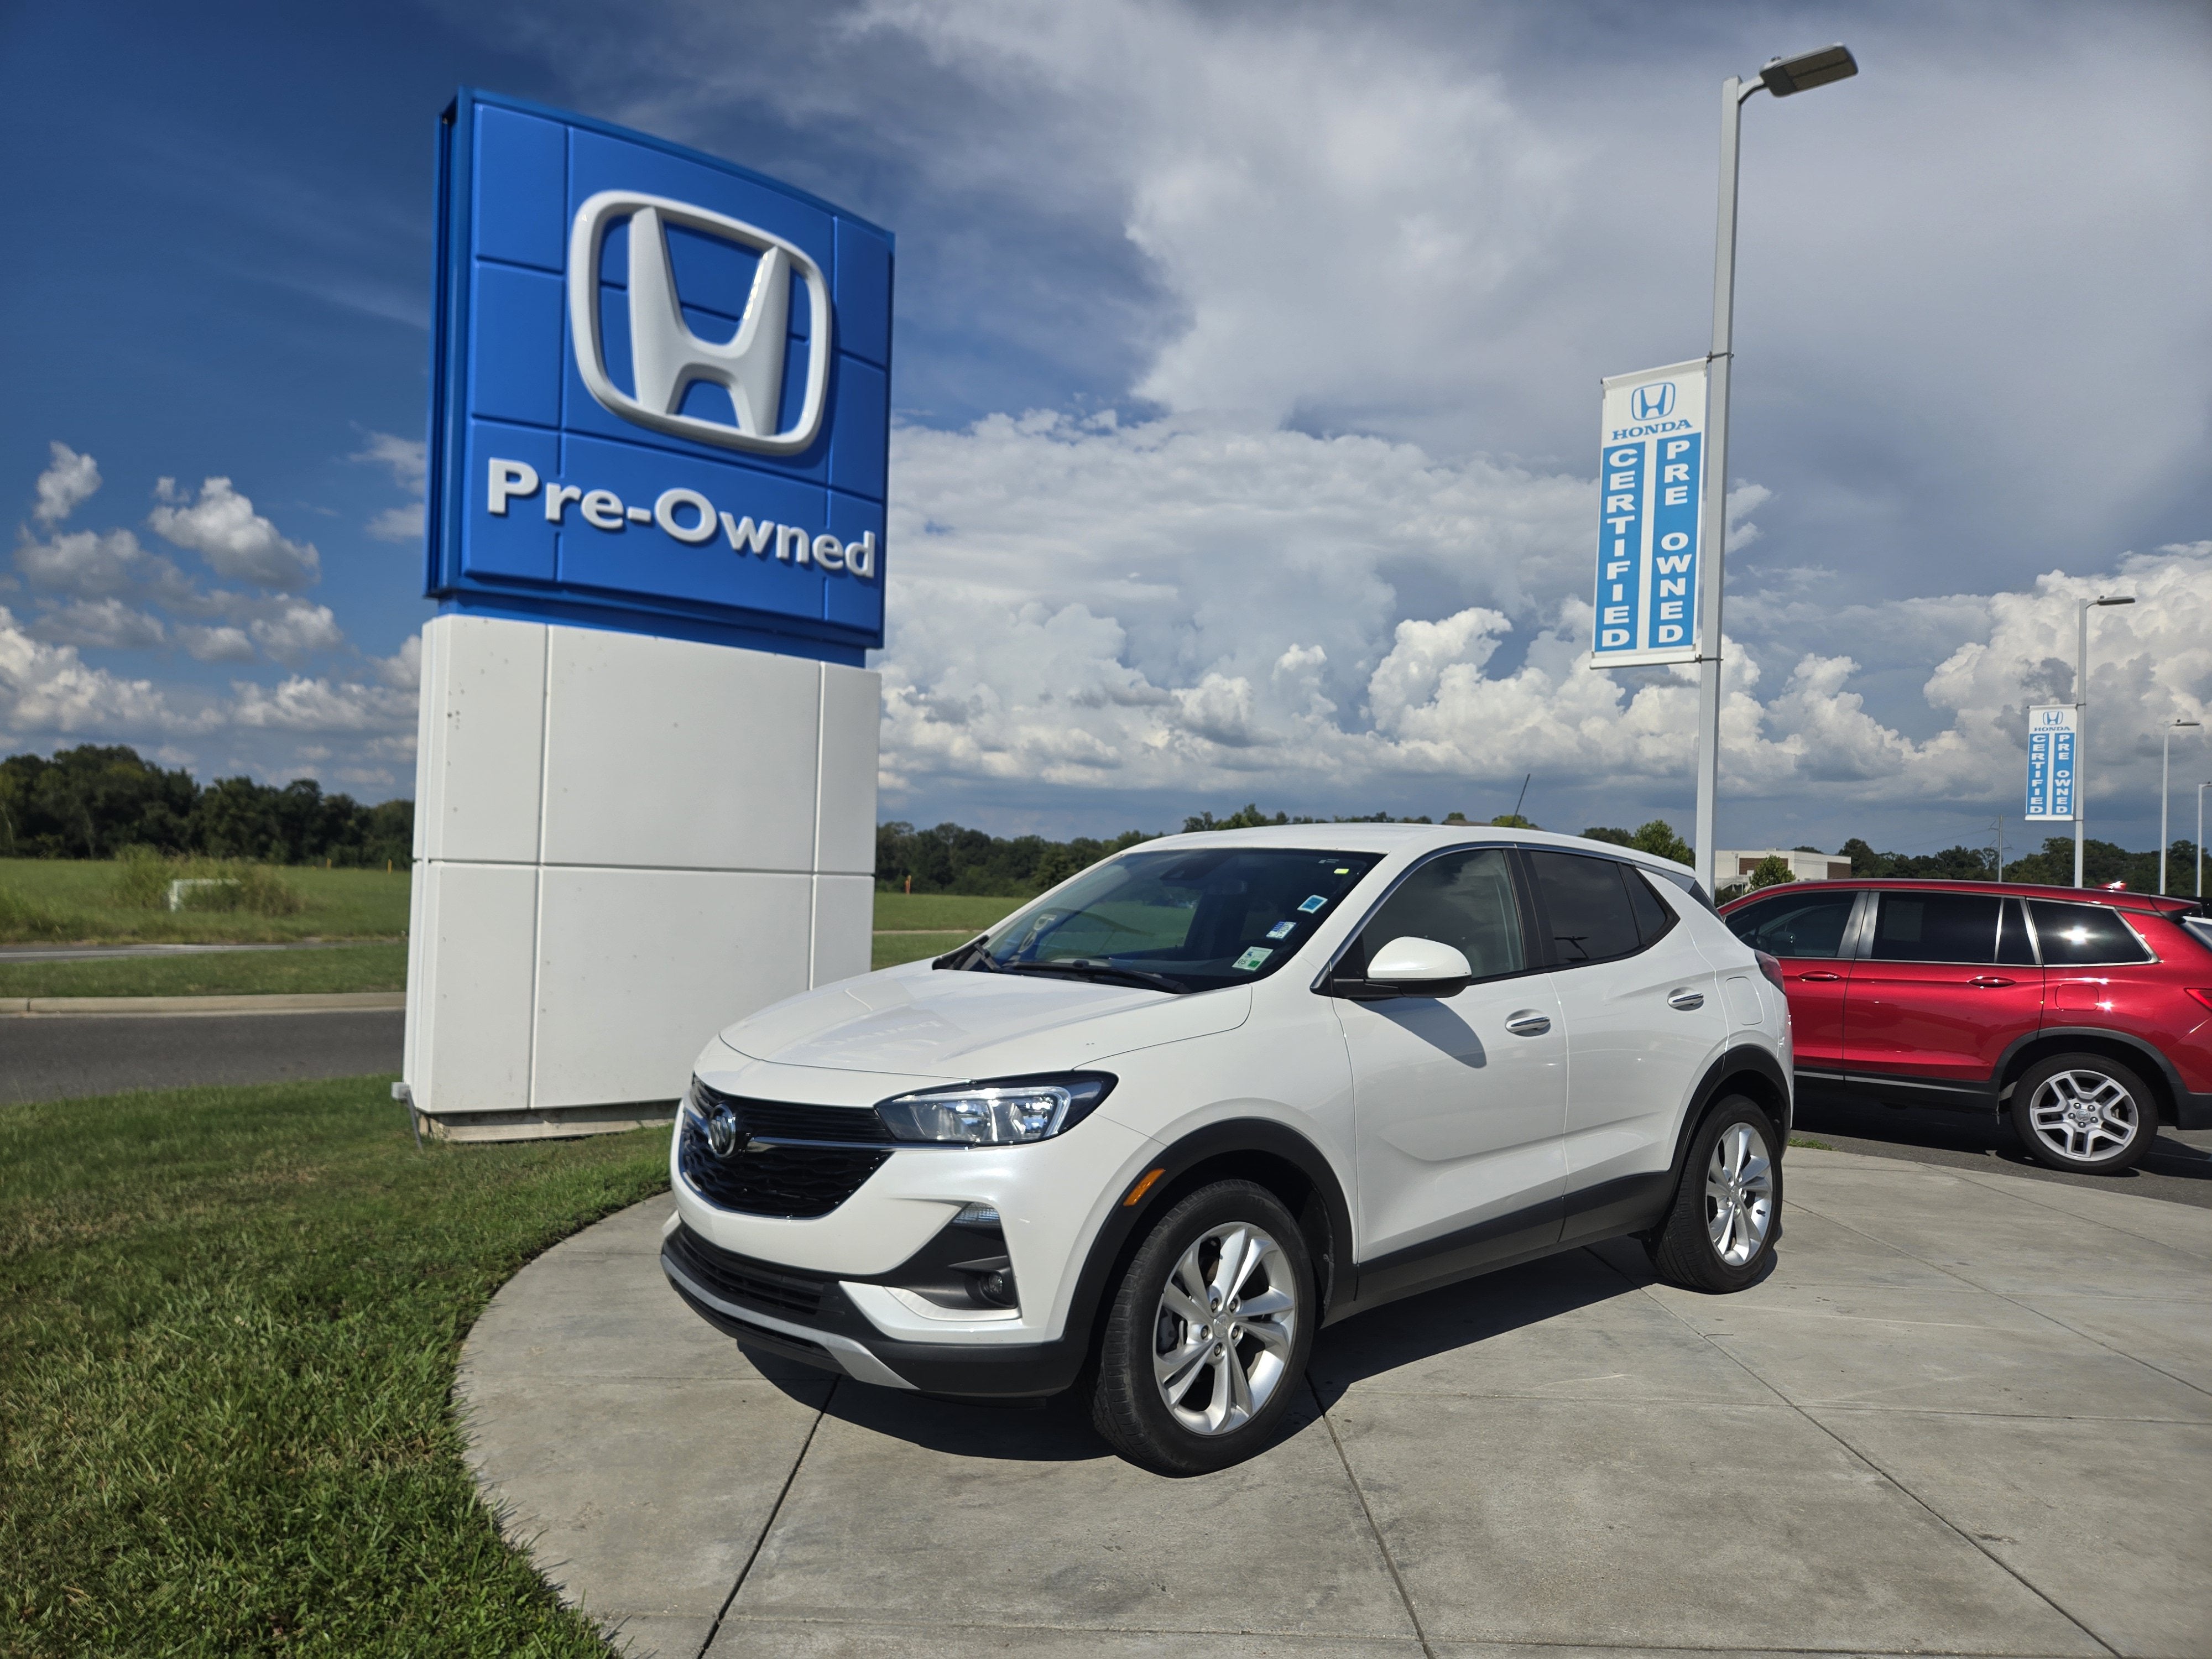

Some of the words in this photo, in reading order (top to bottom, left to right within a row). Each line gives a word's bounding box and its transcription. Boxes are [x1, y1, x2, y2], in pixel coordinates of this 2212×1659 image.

[1612, 419, 1692, 440] HONDA
[1664, 440, 1691, 506] PRE
[487, 457, 875, 578] Pre-Owned
[1601, 448, 1638, 647] CERTIFIED
[1656, 532, 1692, 644] OWNED
[2030, 735, 2046, 813] CERTIFIED
[2058, 734, 2070, 760] PRE
[2054, 770, 2072, 814] OWNED
